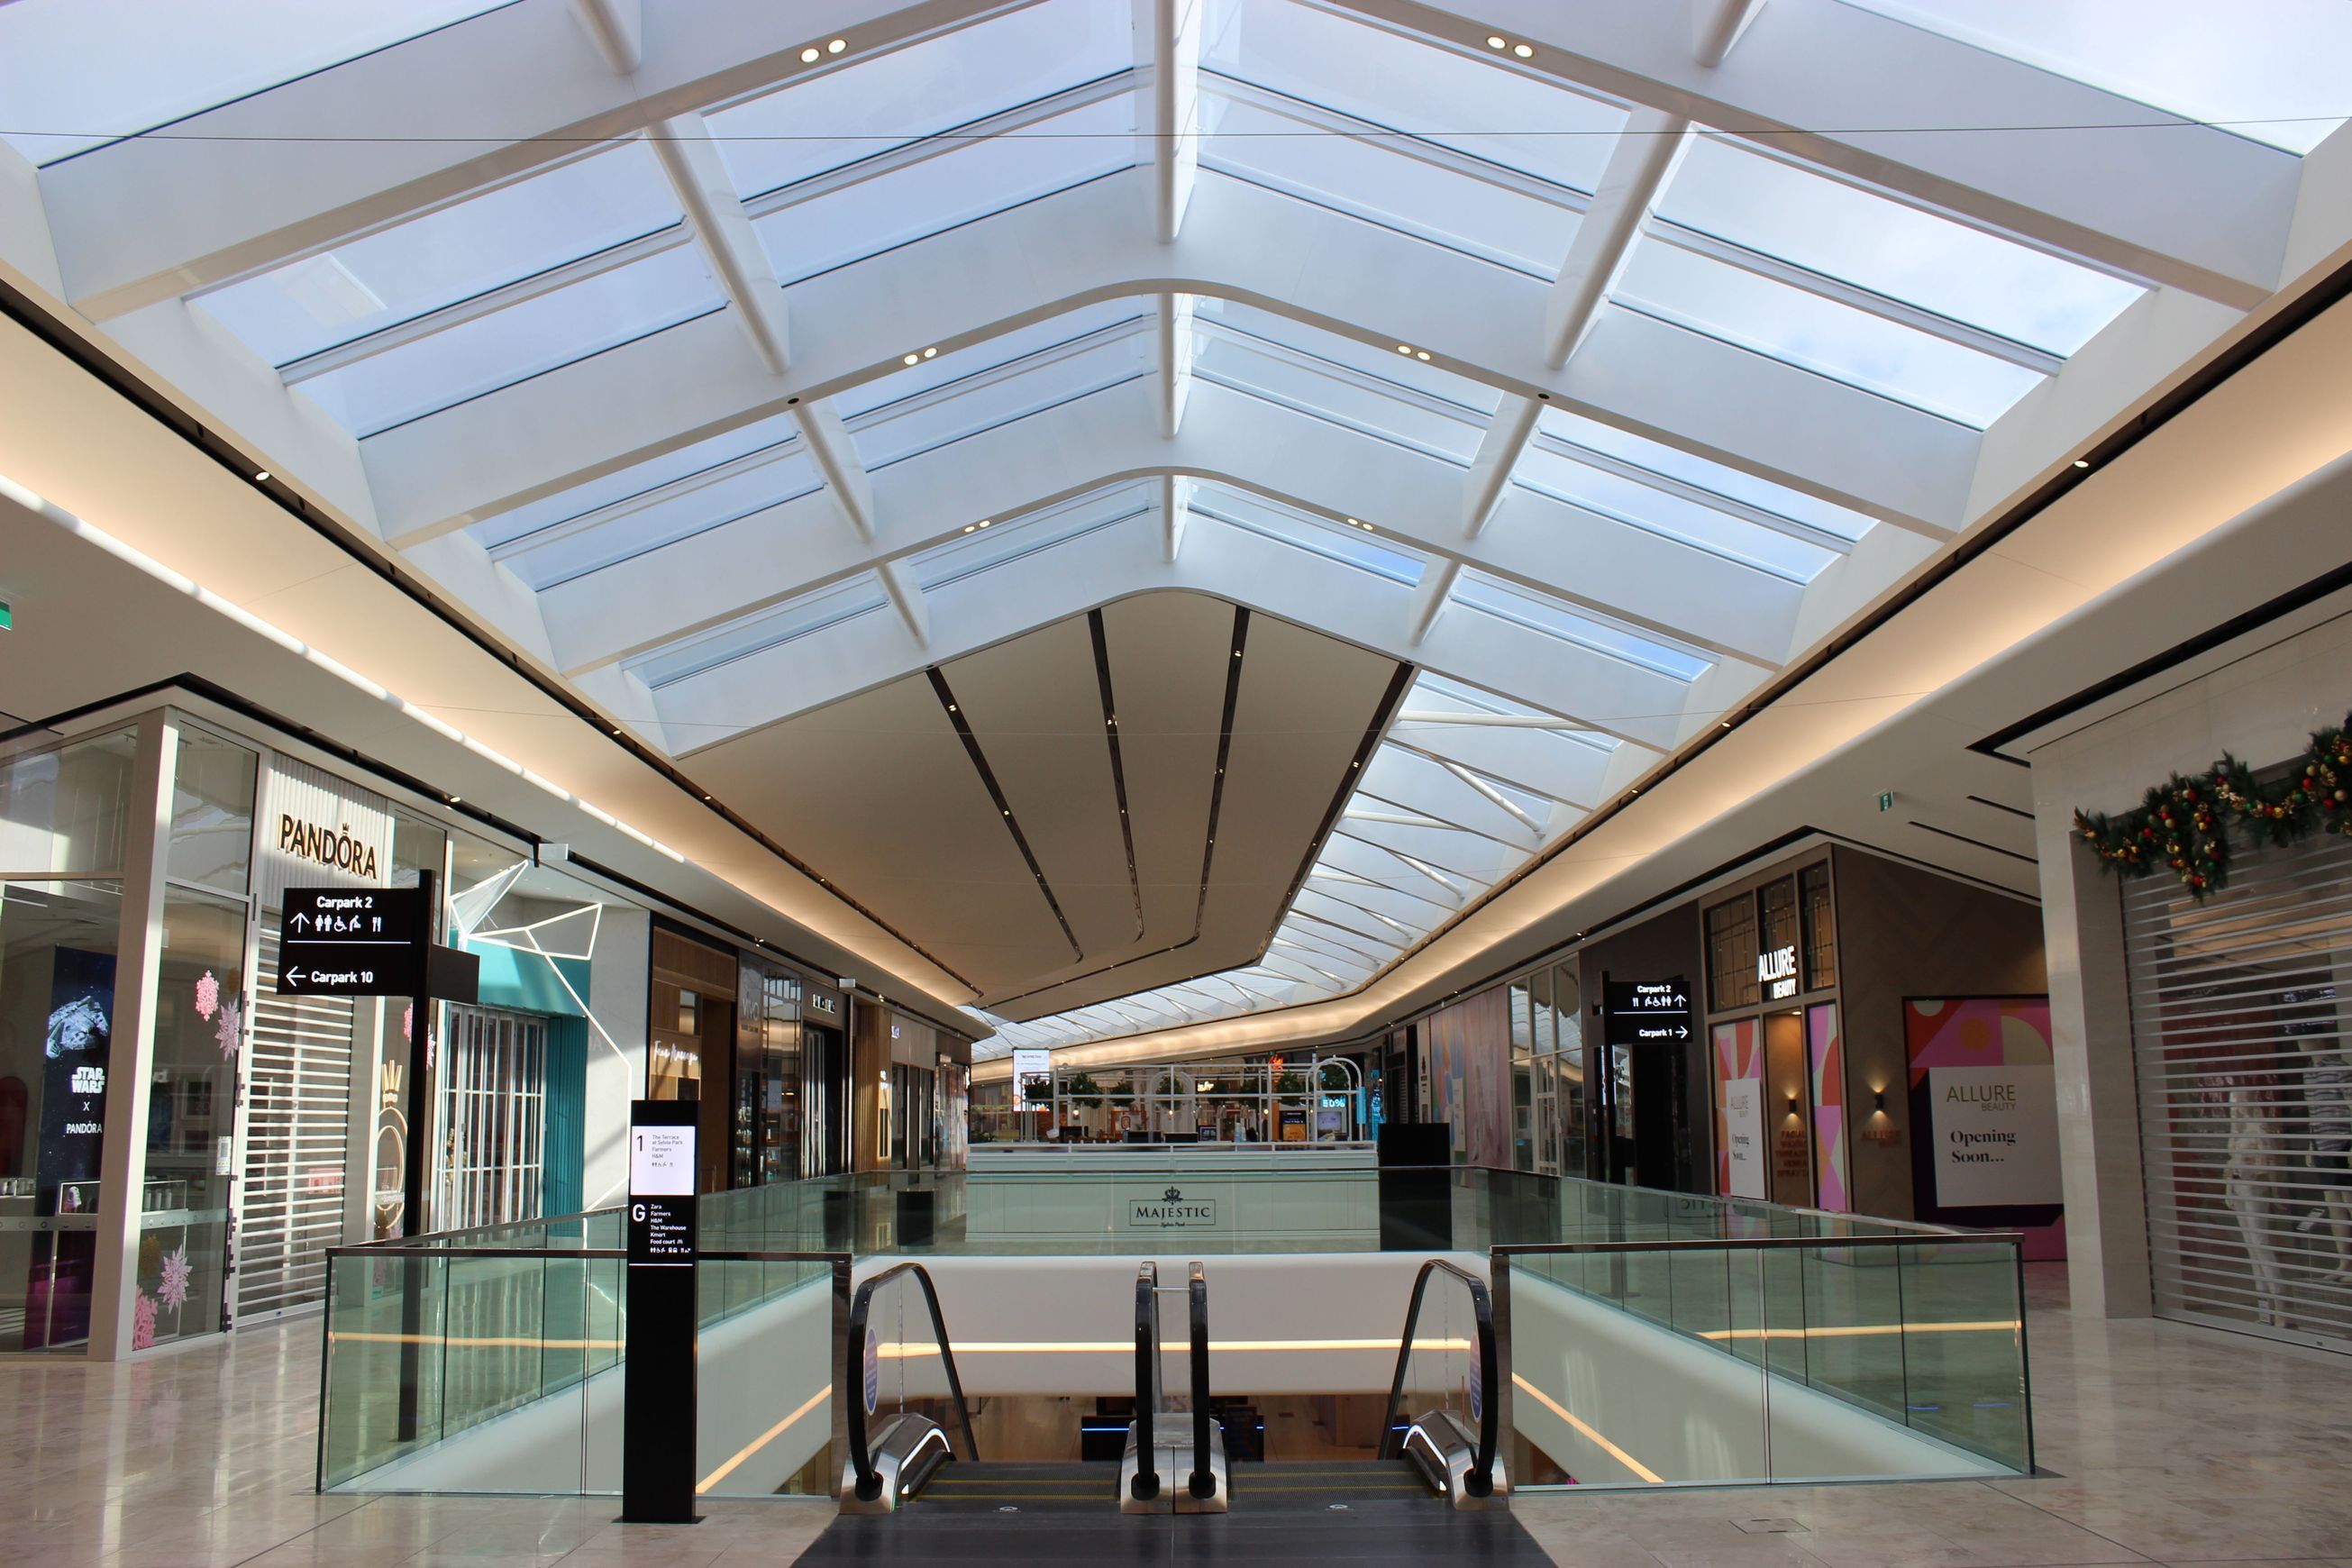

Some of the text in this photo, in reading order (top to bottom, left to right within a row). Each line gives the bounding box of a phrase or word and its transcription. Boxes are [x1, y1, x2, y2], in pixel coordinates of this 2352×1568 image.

[280, 814, 377, 880] PANDORA
[316, 896, 373, 911] Carpark 2
[1758, 944, 1797, 982] ALLURE
[311, 971, 373, 986] Carpark 10
[1636, 984, 1672, 995] Carpark 2
[1773, 978, 1796, 999] BEAUTY
[1639, 1028, 1673, 1038] Carpark 1
[71, 1066, 105, 1080] STAR
[71, 1080, 105, 1094] WARS
[1946, 1084, 2017, 1102] ALLURE
[1322, 1099, 1346, 1108] 50%
[1981, 1102, 2017, 1111] BEAUTY
[636, 1135, 643, 1152] 1
[1950, 1128, 2017, 1147] Opening
[1951, 1150, 2004, 1163] Soon...
[633, 1204, 646, 1222] G
[1135, 1206, 1210, 1219] MAJESTIC
